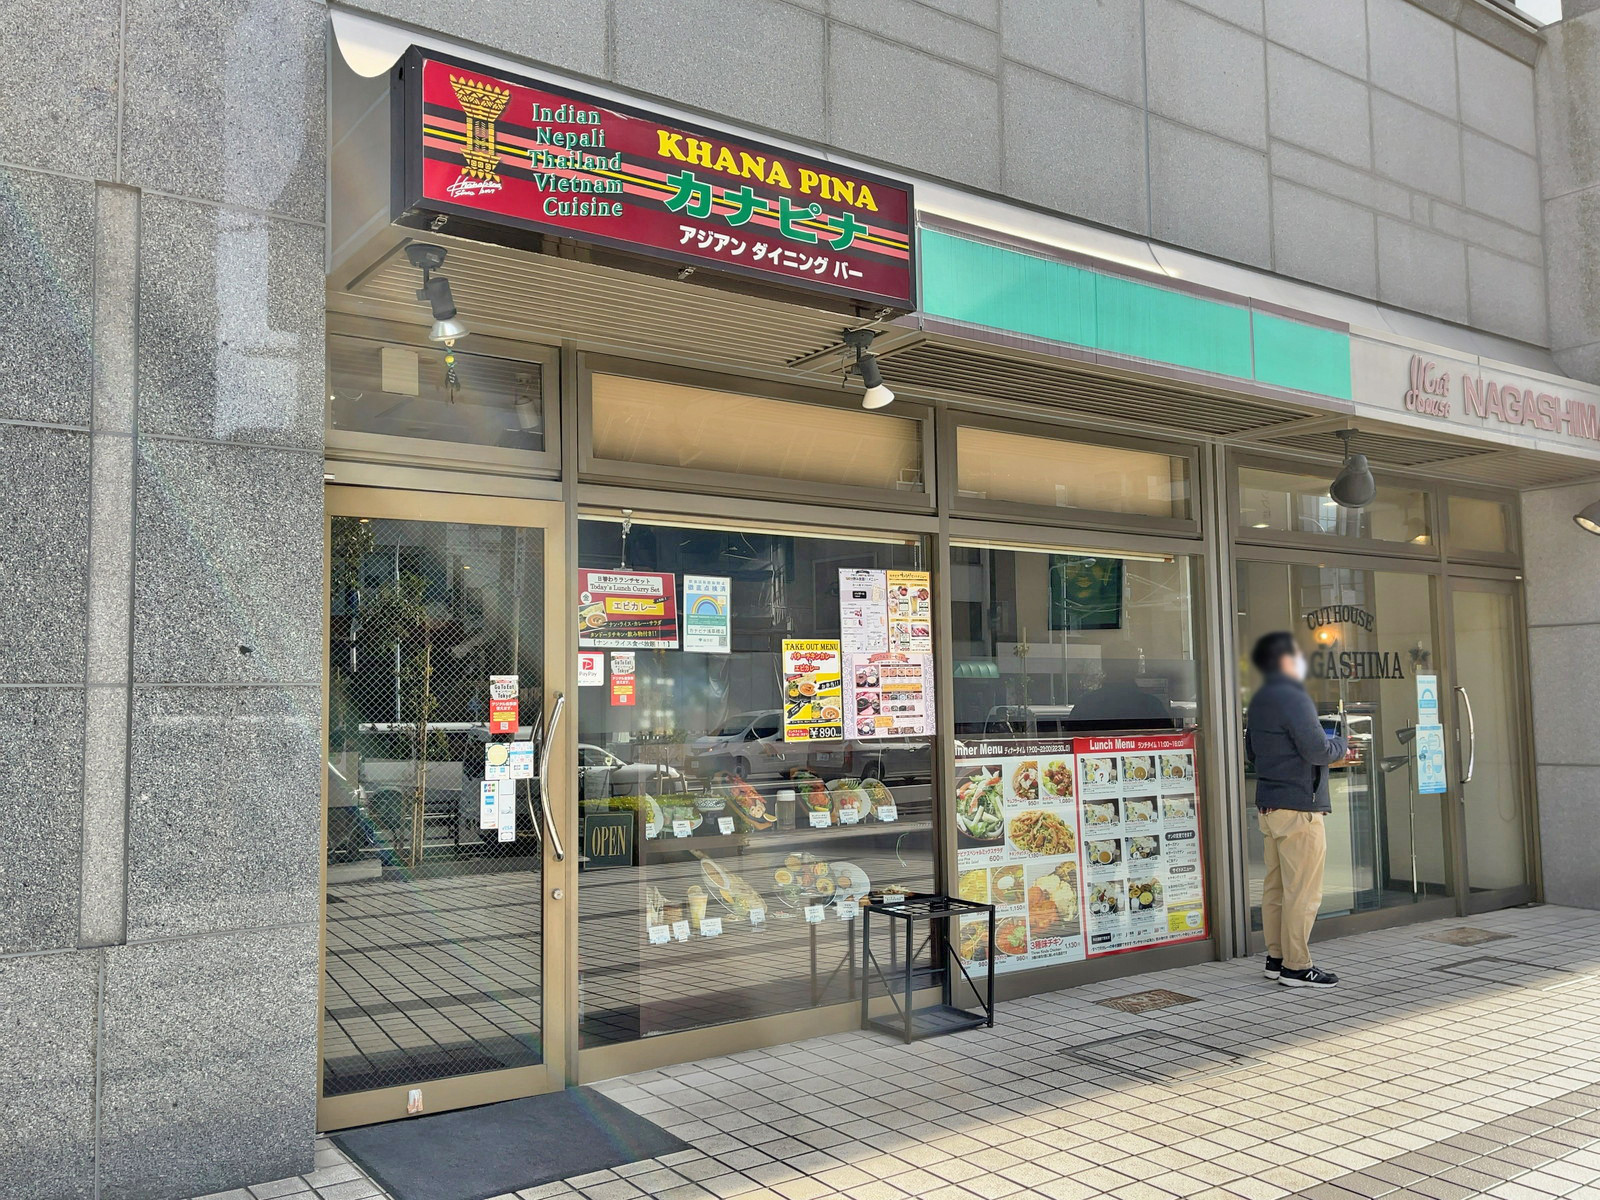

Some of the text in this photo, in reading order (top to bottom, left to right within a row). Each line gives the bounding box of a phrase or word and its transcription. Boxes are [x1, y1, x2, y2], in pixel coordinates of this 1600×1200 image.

[532, 103, 601, 125] Indian
[536, 126, 606, 150] Nepali
[528, 150, 622, 171] Thailand
[656, 129, 879, 211] KHANA PINA
[533, 173, 624, 194] Vietnam
[543, 197, 624, 217] Cuisine
[664, 170, 868, 250] カナピナ
[679, 225, 864, 280] アジアン ダイニング バー
[1463, 374, 1600, 441] NAGASHIM
[614, 602, 657, 611] エビカレー
[1306, 604, 1375, 632] CUTHOUSE
[1309, 651, 1405, 679] GASHIMA
[955, 745, 978, 756] inner
[979, 743, 1003, 755] Menu
[1090, 739, 1113, 750] Lunch
[1115, 738, 1135, 749] Menu
[591, 825, 627, 856] OPEN
